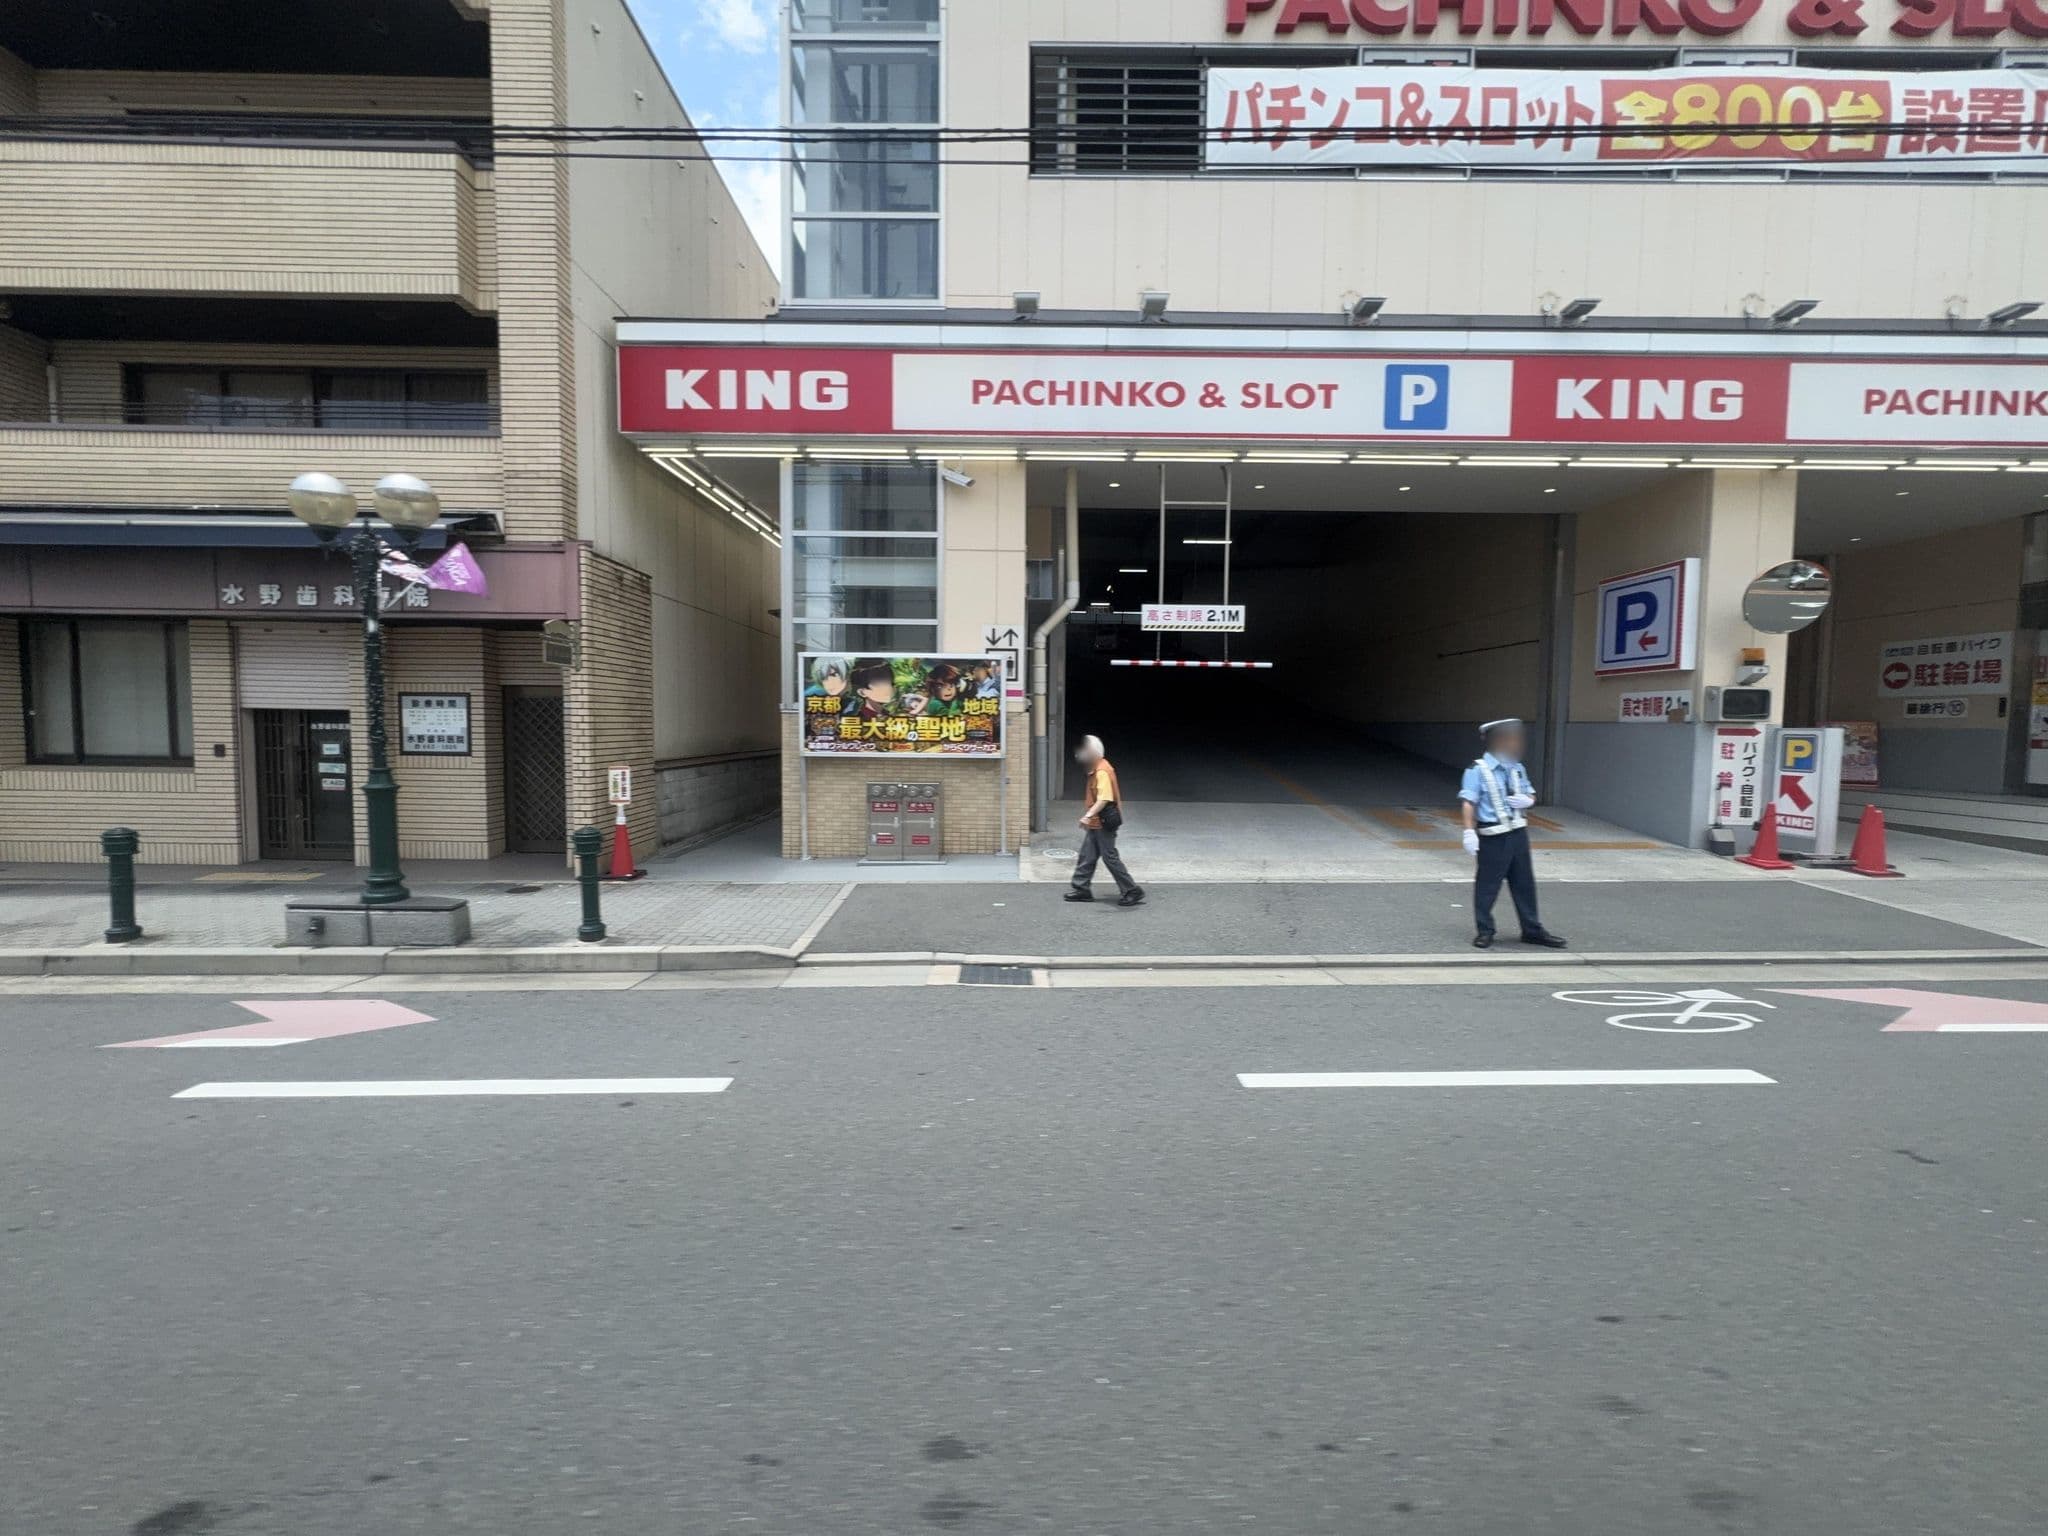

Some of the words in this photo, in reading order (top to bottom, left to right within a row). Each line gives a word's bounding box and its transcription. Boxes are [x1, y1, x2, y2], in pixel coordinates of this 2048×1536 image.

[1891, 0, 2048, 37] SL
[1899, 87, 2048, 154] 設置
[665, 369, 849, 410] KING
[971, 379, 1186, 408] PACHINKO
[1198, 382, 1227, 409] &
[1240, 381, 1339, 410] SLOT
[1399, 375, 1437, 421] P
[1555, 378, 1743, 420] KING
[1147, 609, 1203, 622] 高さ制限
[1207, 609, 1240, 622] 2.1M
[1614, 590, 1658, 655] P
[1915, 659, 2001, 687] 駐輪場
[807, 697, 841, 713] 京都
[963, 698, 999, 715] 地域
[1785, 739, 1813, 768] P
